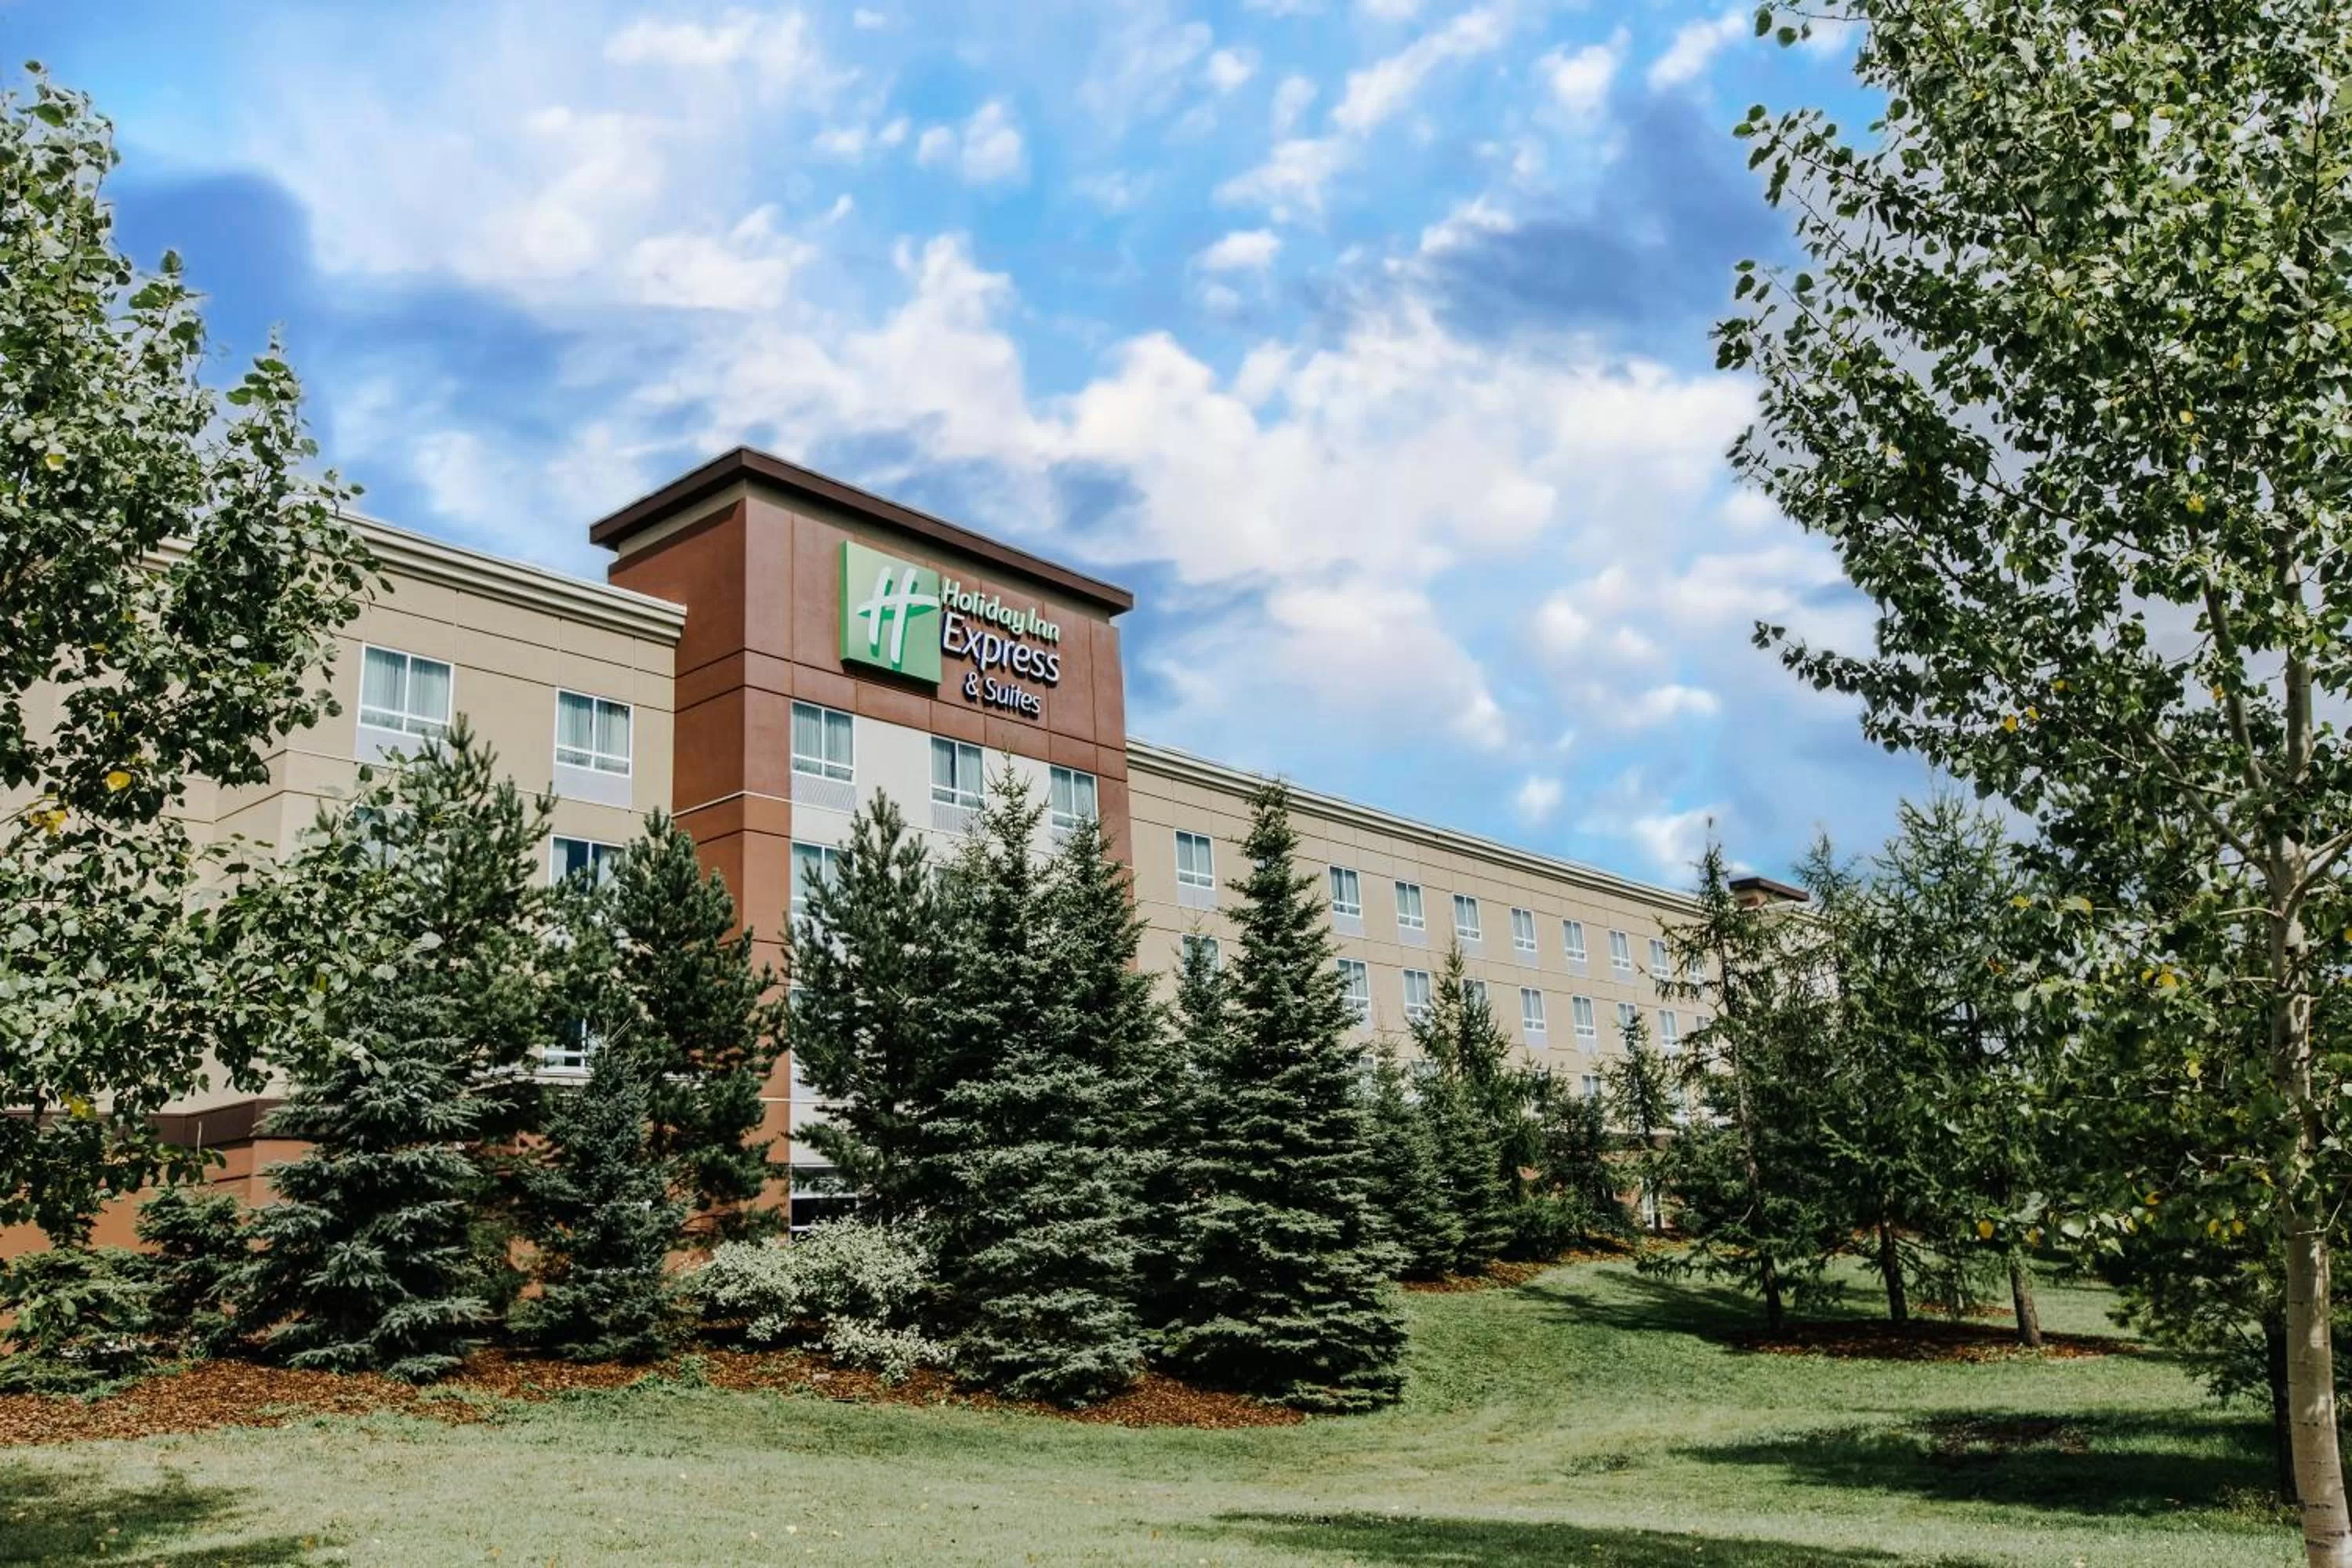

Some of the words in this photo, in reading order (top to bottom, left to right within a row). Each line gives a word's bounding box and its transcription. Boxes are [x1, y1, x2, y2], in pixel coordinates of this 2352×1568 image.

[941, 577, 1025, 633] Holiday
[1026, 607, 1060, 642] Inn
[942, 612, 1060, 682] Express
[965, 672, 979, 696] &
[984, 677, 1042, 713] Suites
